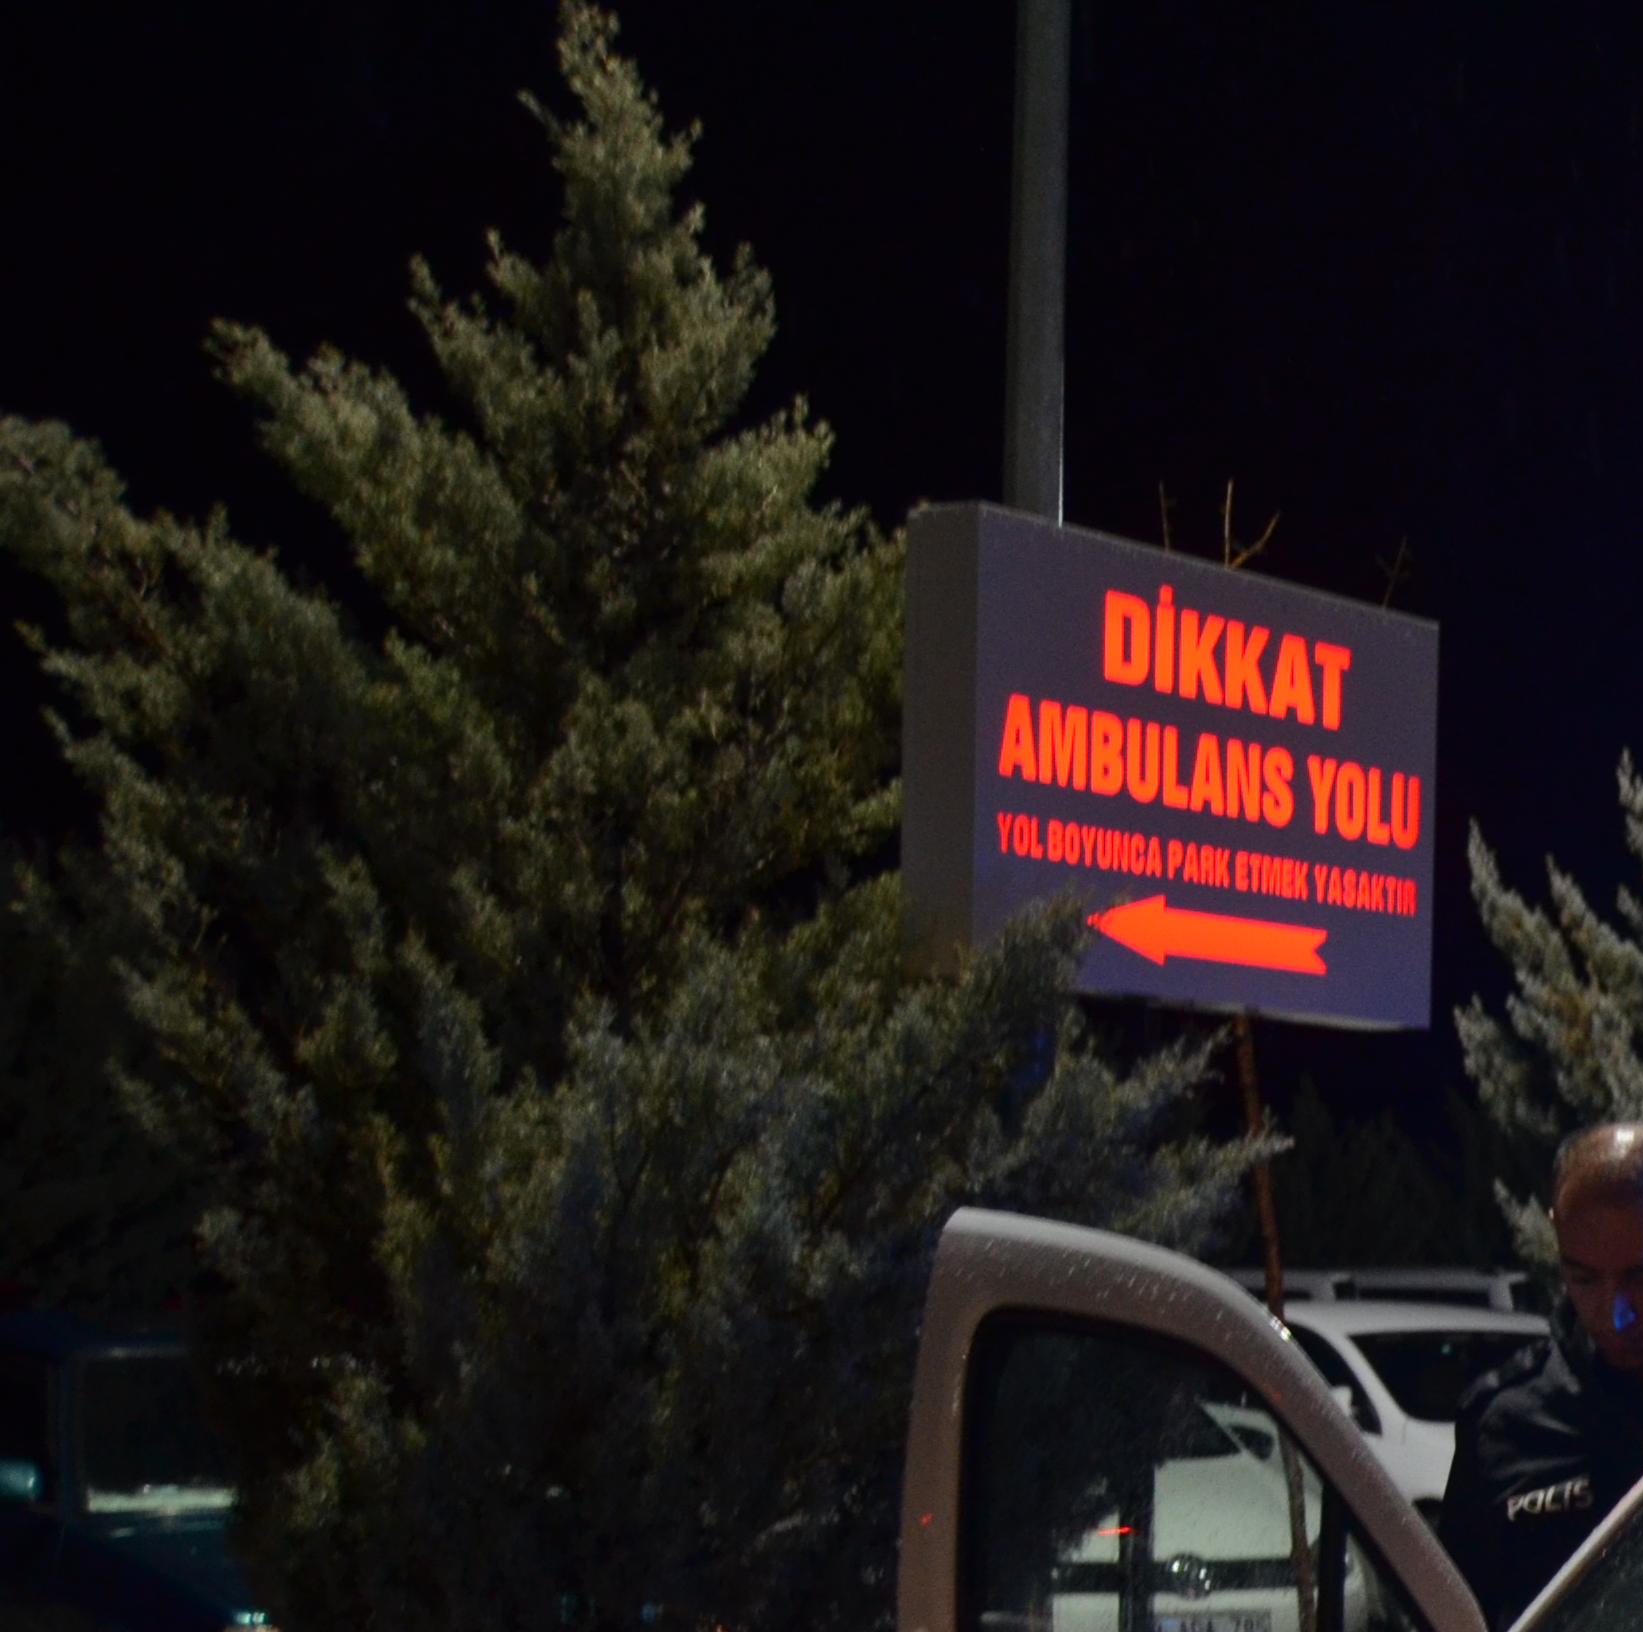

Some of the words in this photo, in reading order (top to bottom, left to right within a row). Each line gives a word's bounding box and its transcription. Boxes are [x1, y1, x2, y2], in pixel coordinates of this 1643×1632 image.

[1103, 584, 1351, 730] DİKKAT
[999, 693, 1294, 828] AMBULANS
[1307, 755, 1420, 850] YOLU
[997, 812, 1044, 859] YOL
[1047, 819, 1163, 878] BOYUNCA
[1167, 839, 1230, 888] PARK
[1235, 851, 1309, 900] ETMEK
[1314, 864, 1416, 916] YASAKTIR
